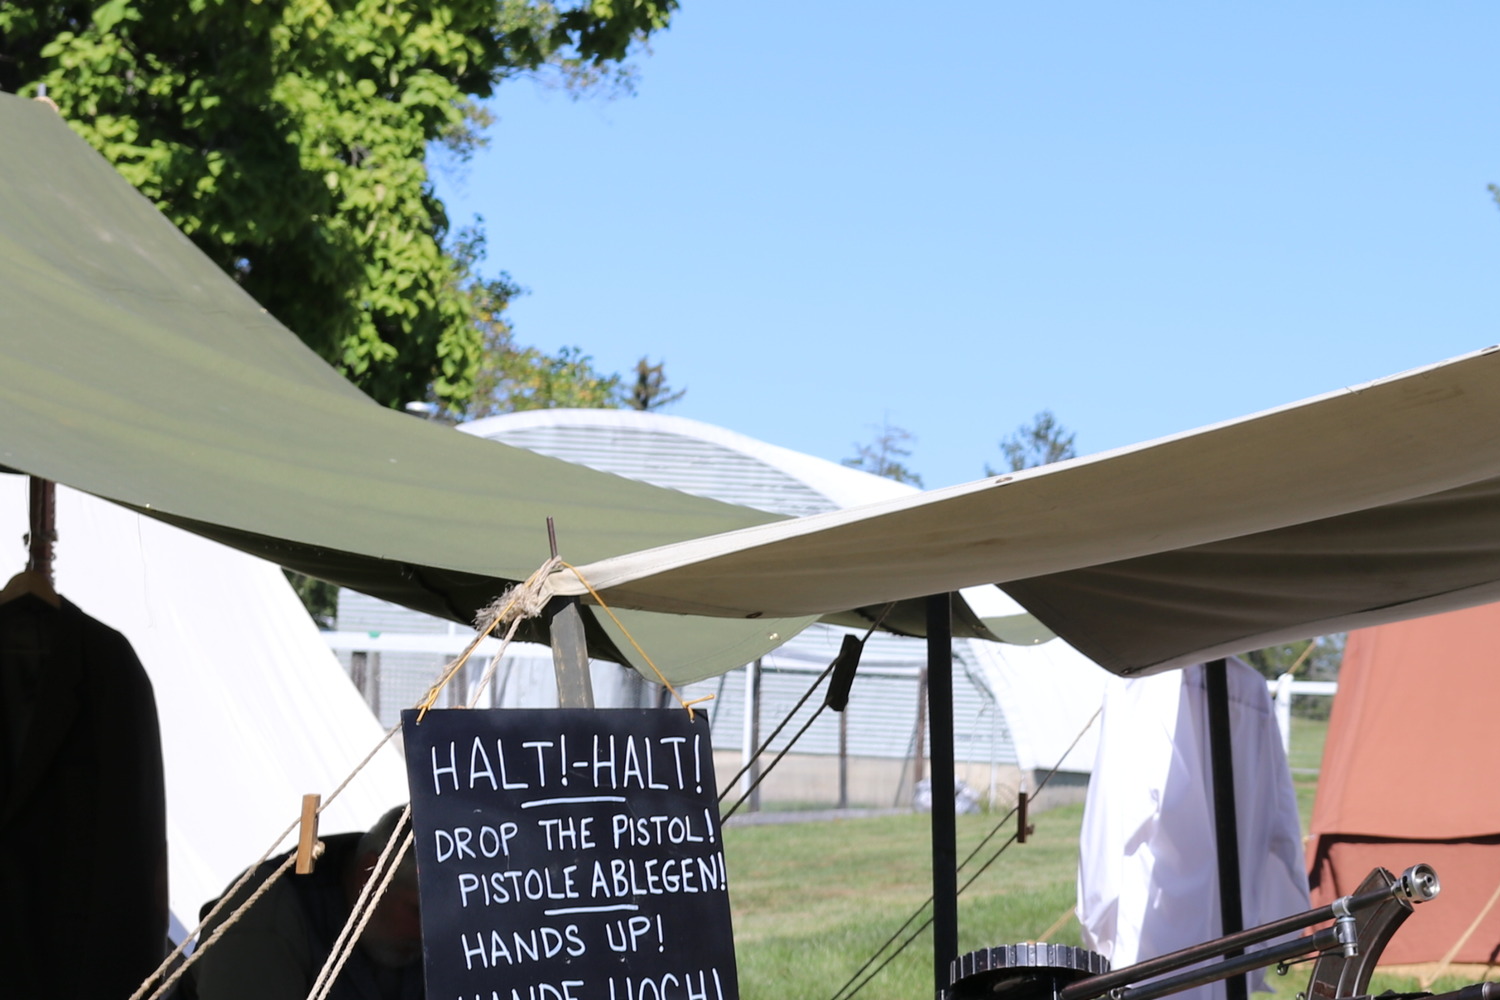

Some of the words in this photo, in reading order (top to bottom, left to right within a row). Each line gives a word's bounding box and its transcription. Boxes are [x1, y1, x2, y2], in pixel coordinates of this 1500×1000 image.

[435, 823, 517, 862] DROP
[538, 817, 595, 850] THE
[613, 809, 714, 848] PISTOL!
[458, 866, 580, 907] PISTOLE
[591, 852, 727, 898] ABLEGEN!
[462, 925, 585, 969] HANDS
[606, 914, 663, 952] UP!
